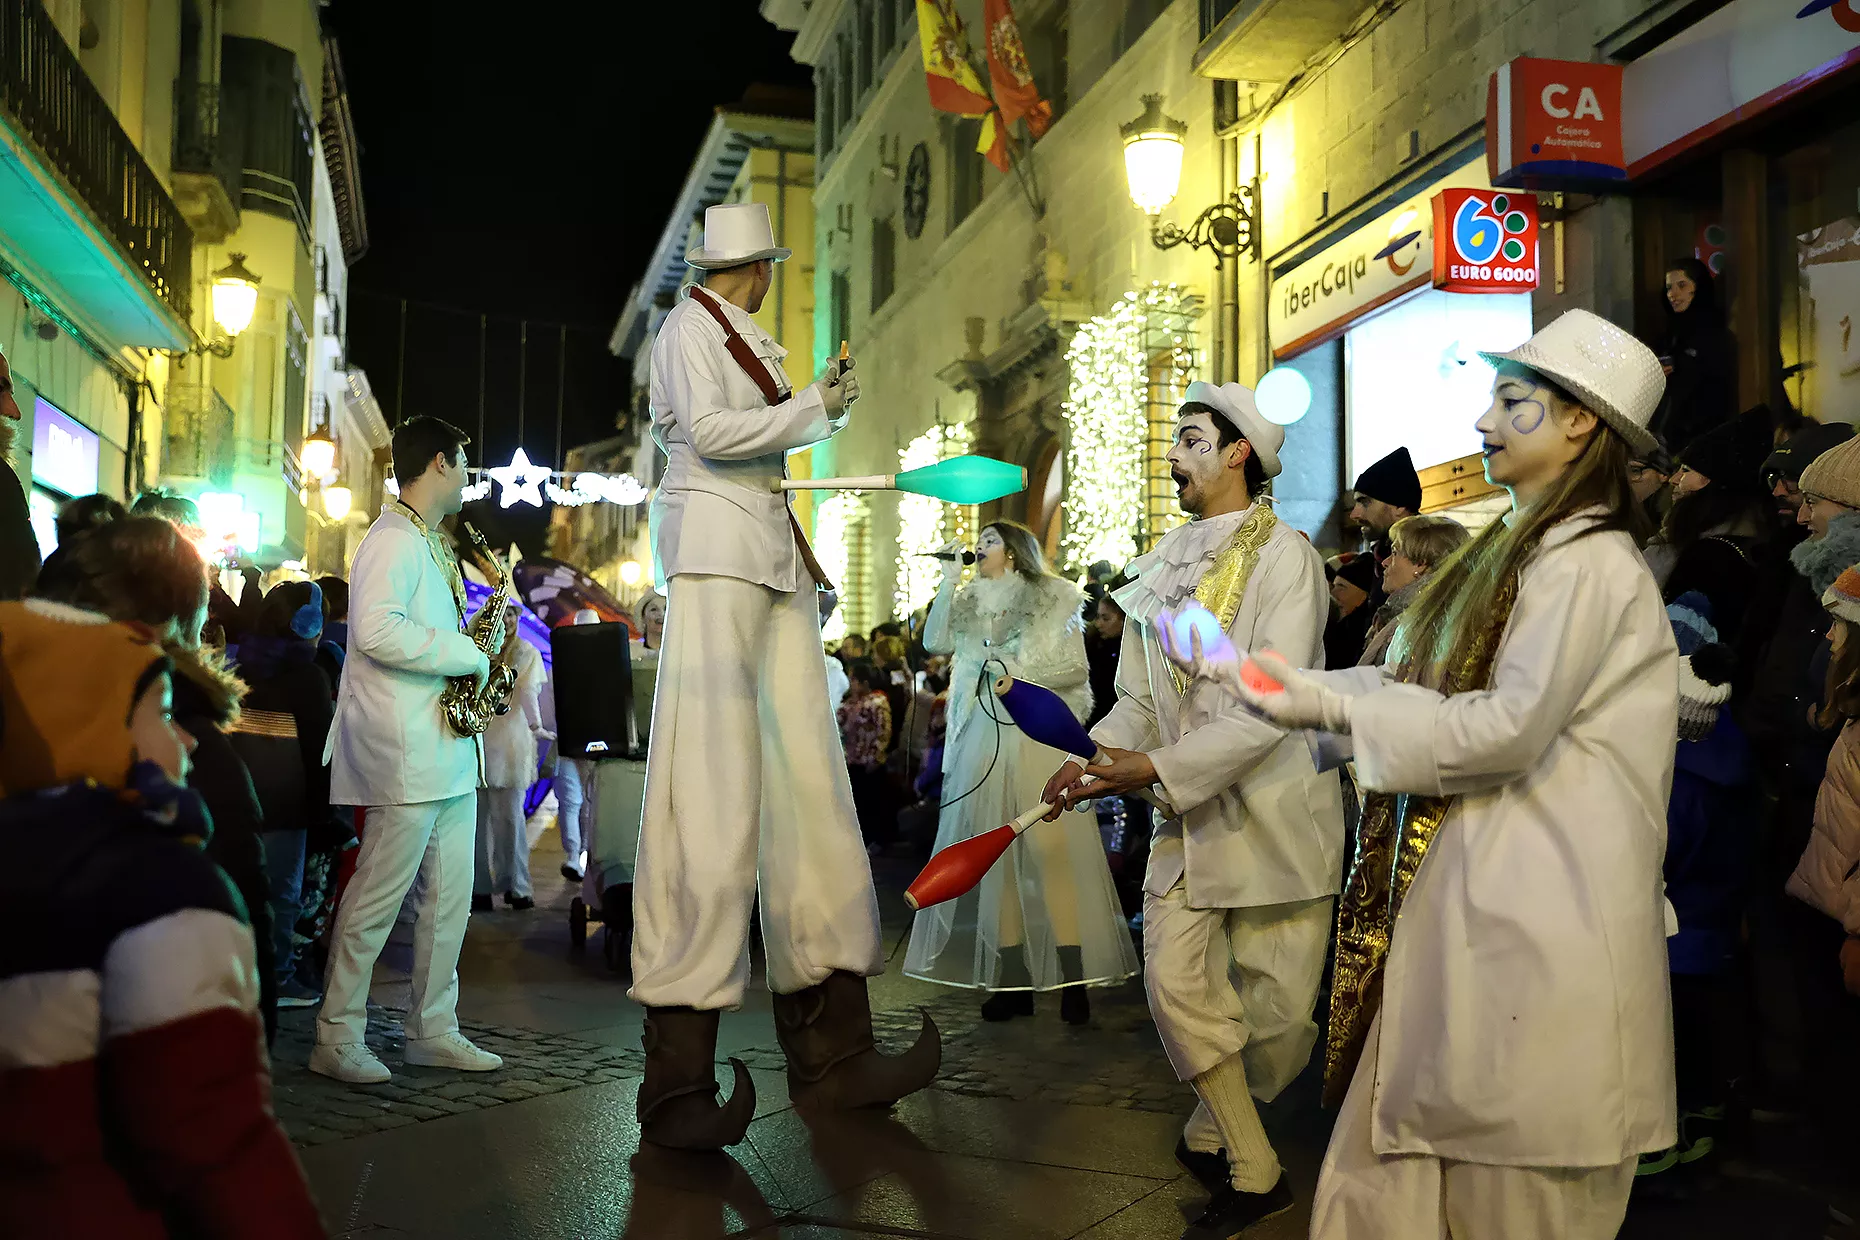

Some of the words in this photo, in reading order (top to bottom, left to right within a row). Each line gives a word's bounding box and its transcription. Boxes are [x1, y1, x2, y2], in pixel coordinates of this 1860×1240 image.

[1541, 83, 1604, 121] CA
[1283, 253, 1367, 319] iberCaja
[1450, 264, 1492, 281] EURO
[1493, 266, 1535, 283] 6000
